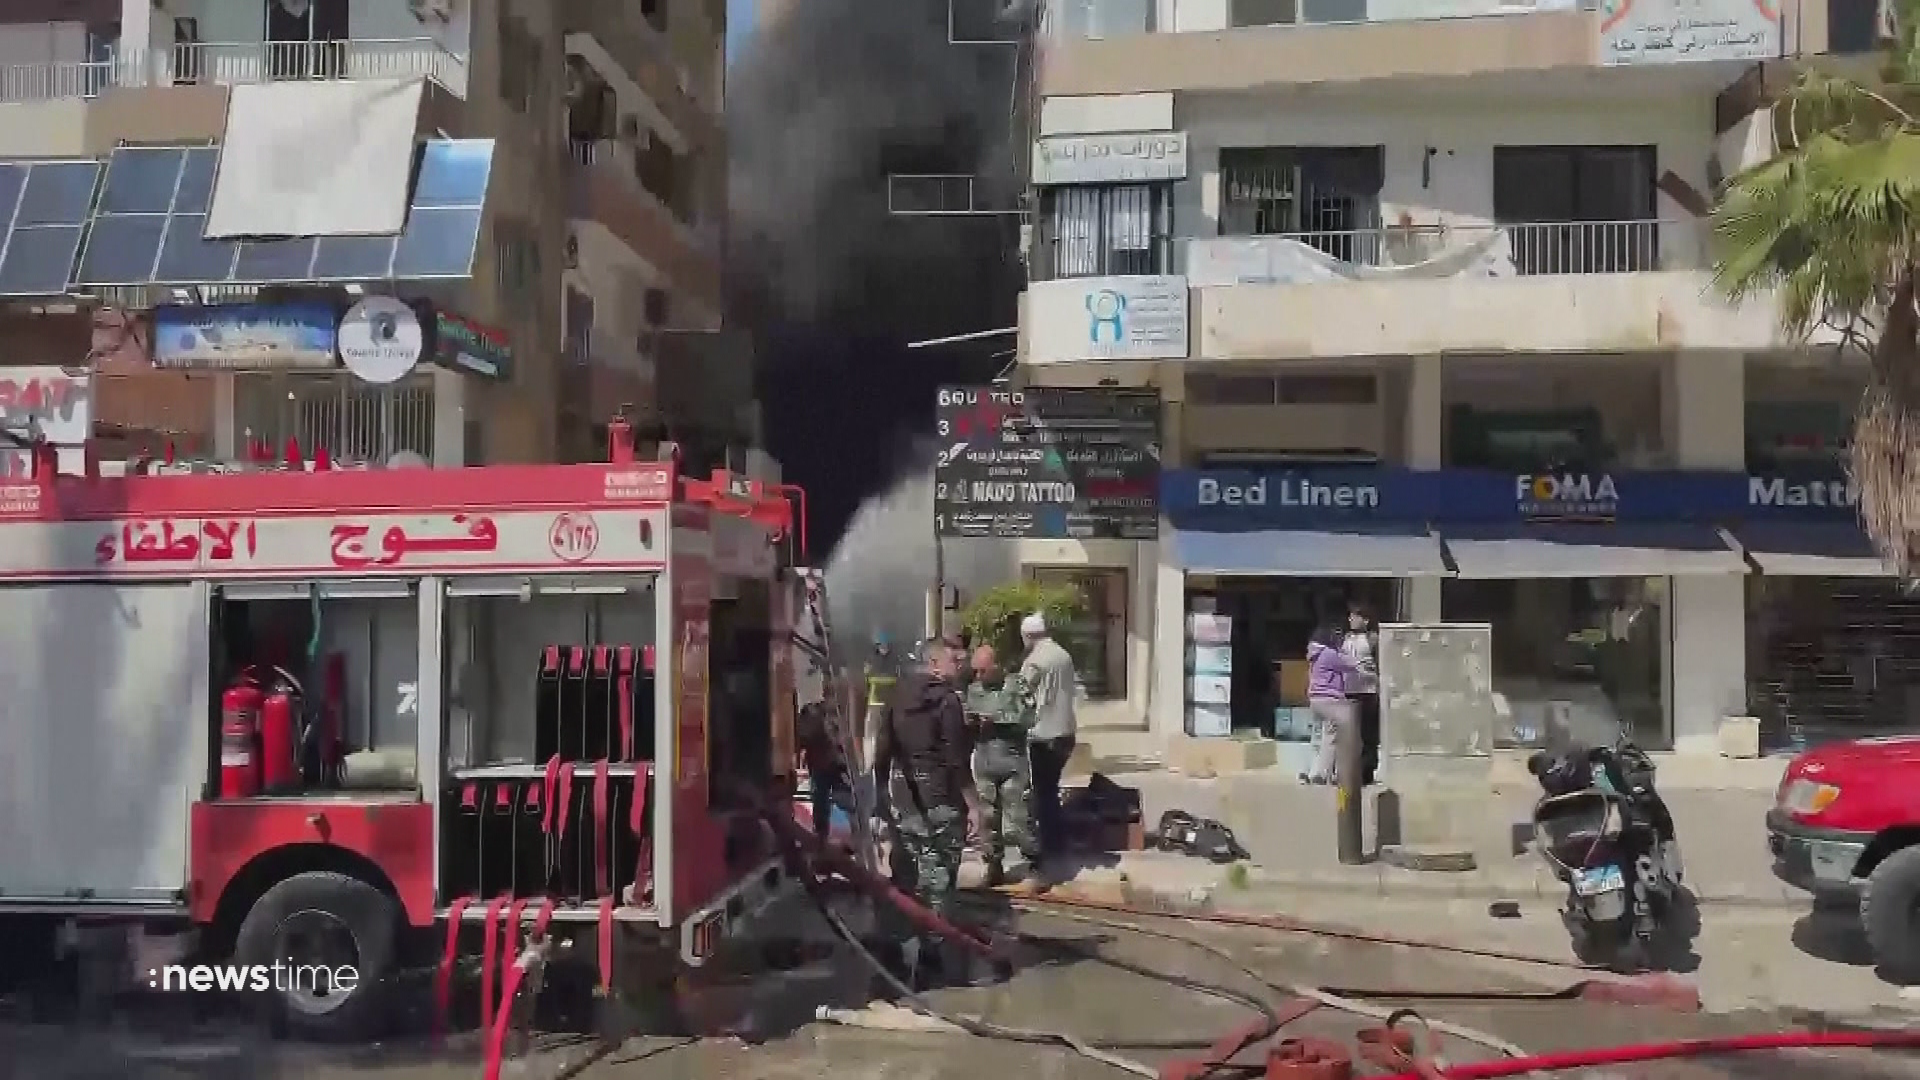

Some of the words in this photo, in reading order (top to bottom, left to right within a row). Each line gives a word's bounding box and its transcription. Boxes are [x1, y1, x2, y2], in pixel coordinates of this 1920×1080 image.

[1020, 482, 1075, 502] TATTOO
[1198, 476, 1268, 506] Bed
[1281, 479, 1379, 506] Linen
[1516, 473, 1619, 500] FOMA
[331, 513, 498, 571] فوج
